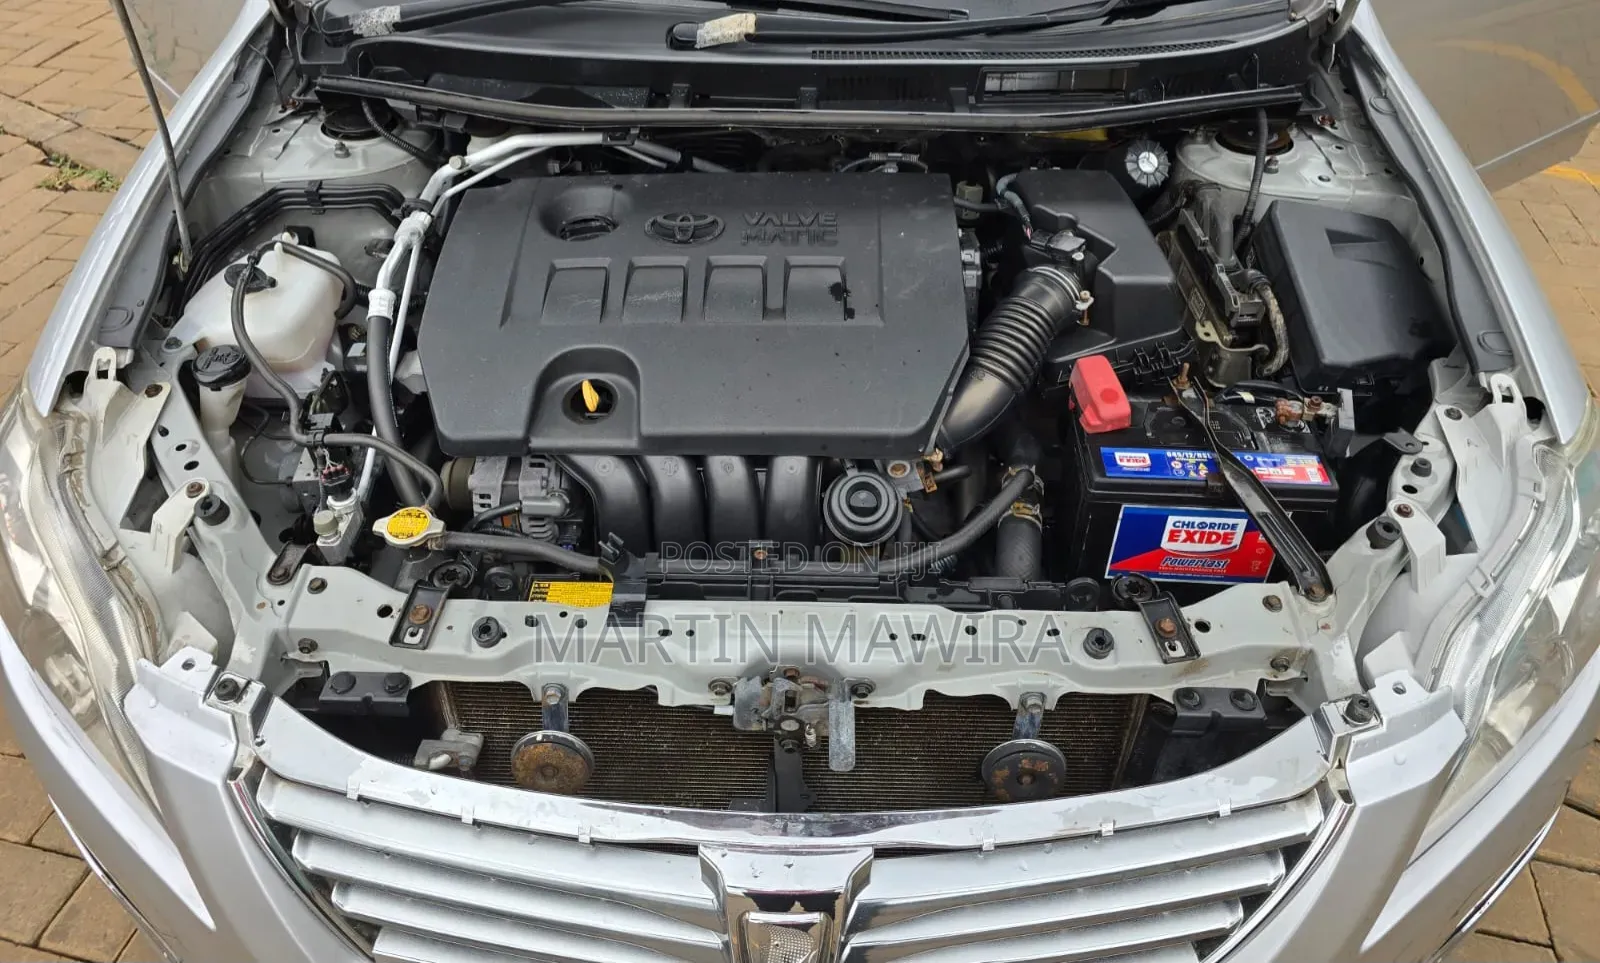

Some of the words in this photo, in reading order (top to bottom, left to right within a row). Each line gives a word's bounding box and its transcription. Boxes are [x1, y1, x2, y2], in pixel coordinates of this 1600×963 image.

[742, 211, 838, 227] VALVE
[741, 228, 839, 246] MATIC
[1172, 520, 1239, 531] CHLORIDE
[1167, 529, 1237, 545] EXIDE
